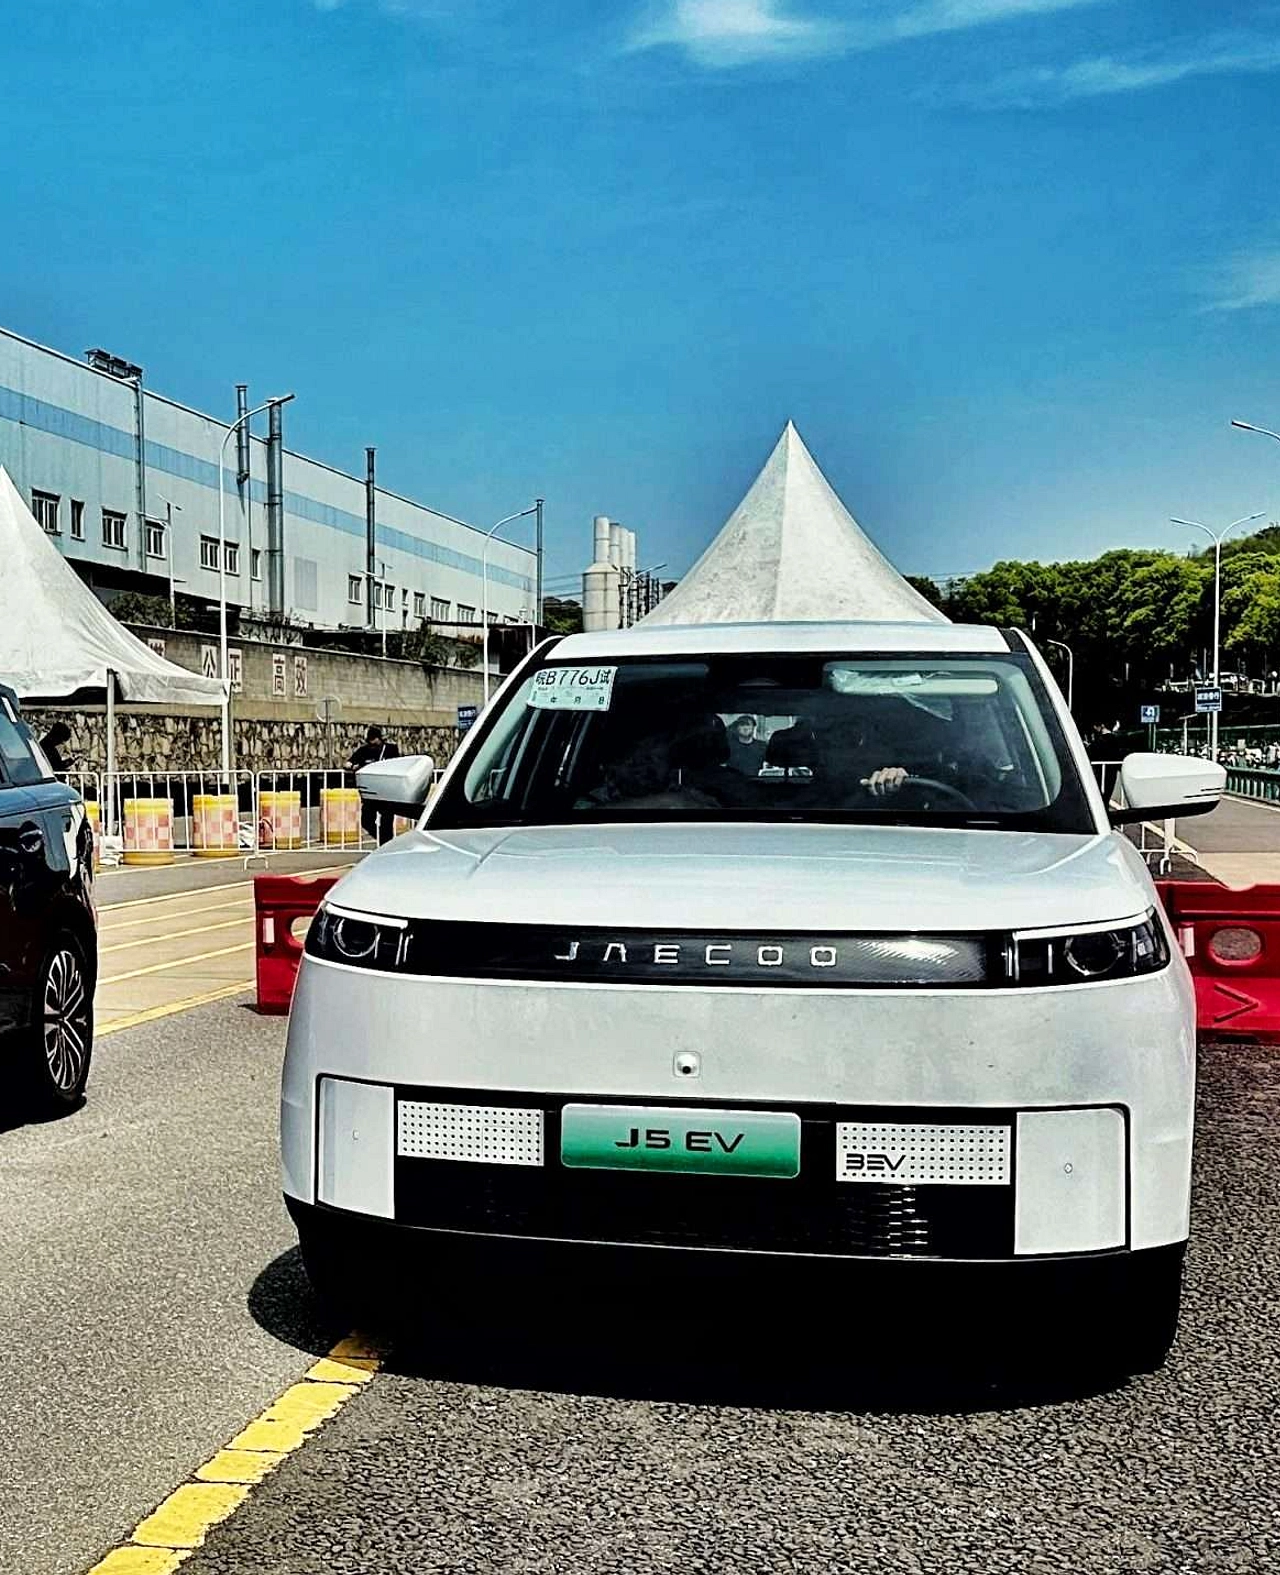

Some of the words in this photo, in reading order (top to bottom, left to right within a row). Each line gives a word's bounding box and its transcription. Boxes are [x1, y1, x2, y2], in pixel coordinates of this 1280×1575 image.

[554, 941, 837, 967] JAECOO
[614, 1128, 671, 1149] J5
[685, 1131, 745, 1153] EV
[846, 1153, 907, 1171] BEV
